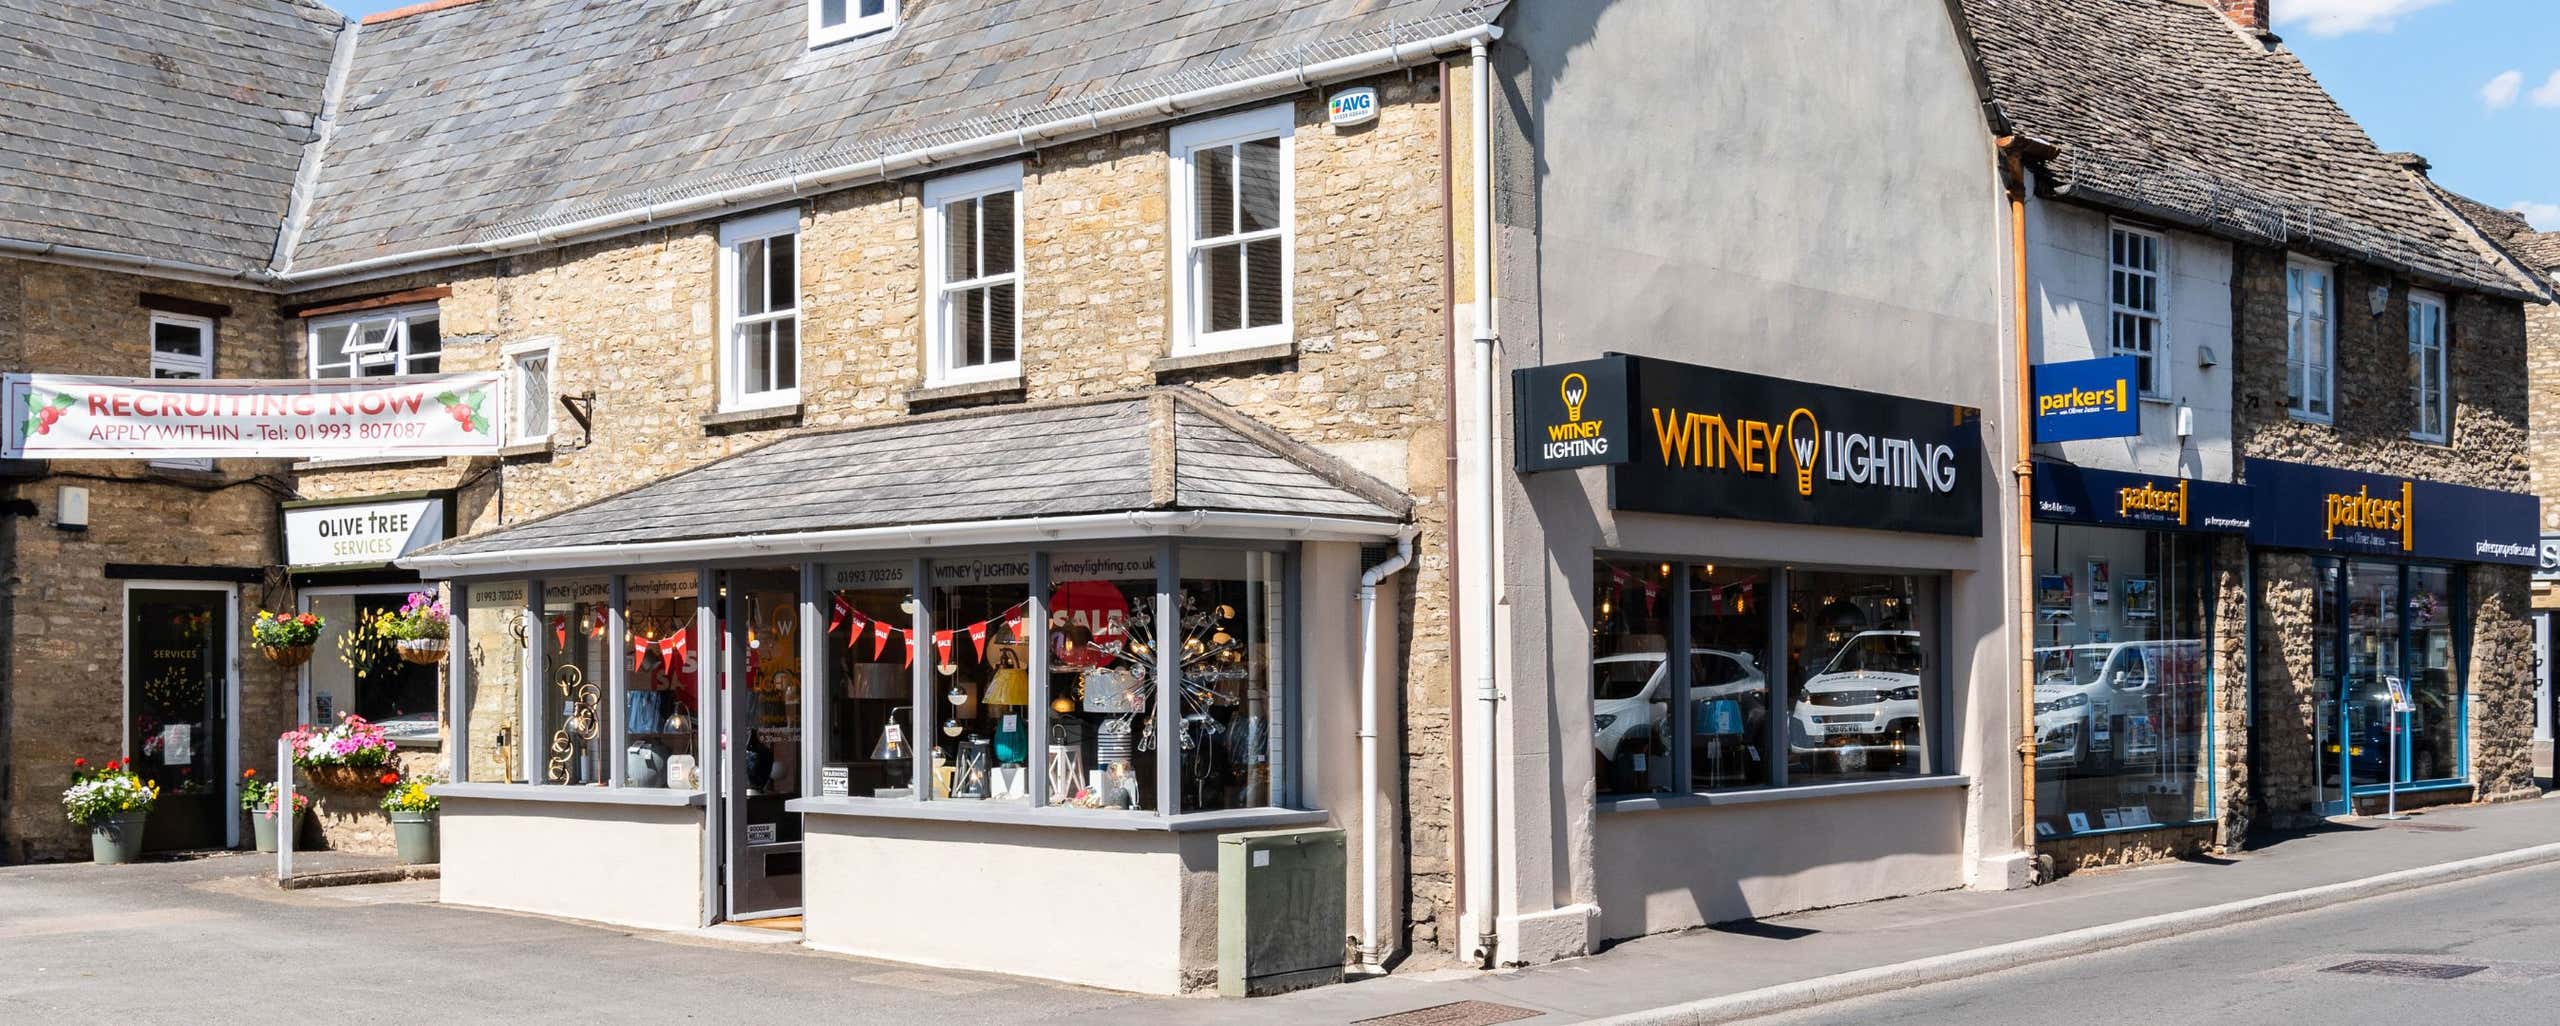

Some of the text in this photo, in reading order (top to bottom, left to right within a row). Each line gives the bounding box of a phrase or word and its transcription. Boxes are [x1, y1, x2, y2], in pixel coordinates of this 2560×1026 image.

[1342, 94, 1370, 112] AVG
[88, 391, 424, 417] RECRUITING NOW
[1566, 388, 1582, 405] W
[2039, 387, 2115, 417] parkers
[88, 424, 151, 441] APPLY
[156, 424, 239, 441] WITHIN
[257, 424, 288, 441] Tel:
[295, 423, 350, 441] 01993
[359, 422, 427, 440] 807087
[1548, 420, 1603, 442] WITNEY
[1543, 437, 1608, 460] LIGHTING
[1651, 407, 1956, 493] WITNEY W LIGHTING
[2121, 481, 2180, 519] parkers
[2327, 484, 2402, 541] parkers
[318, 517, 363, 538] OLIVE
[334, 538, 393, 556] SERVICES
[935, 564, 971, 580] WITNEY
[983, 562, 1030, 578] LIGHTING
[1053, 556, 1157, 576] witneylighting.co.uk
[838, 568, 904, 585] 01993 703265
[475, 590, 523, 603] 01993 703265
[545, 586, 570, 599] WITNEY
[1052, 609, 1124, 636] SALE
[875, 629, 887, 640] SALE
[937, 639, 952, 648] SALE
[971, 631, 986, 641] SALE
[153, 649, 198, 659] SERVICES
